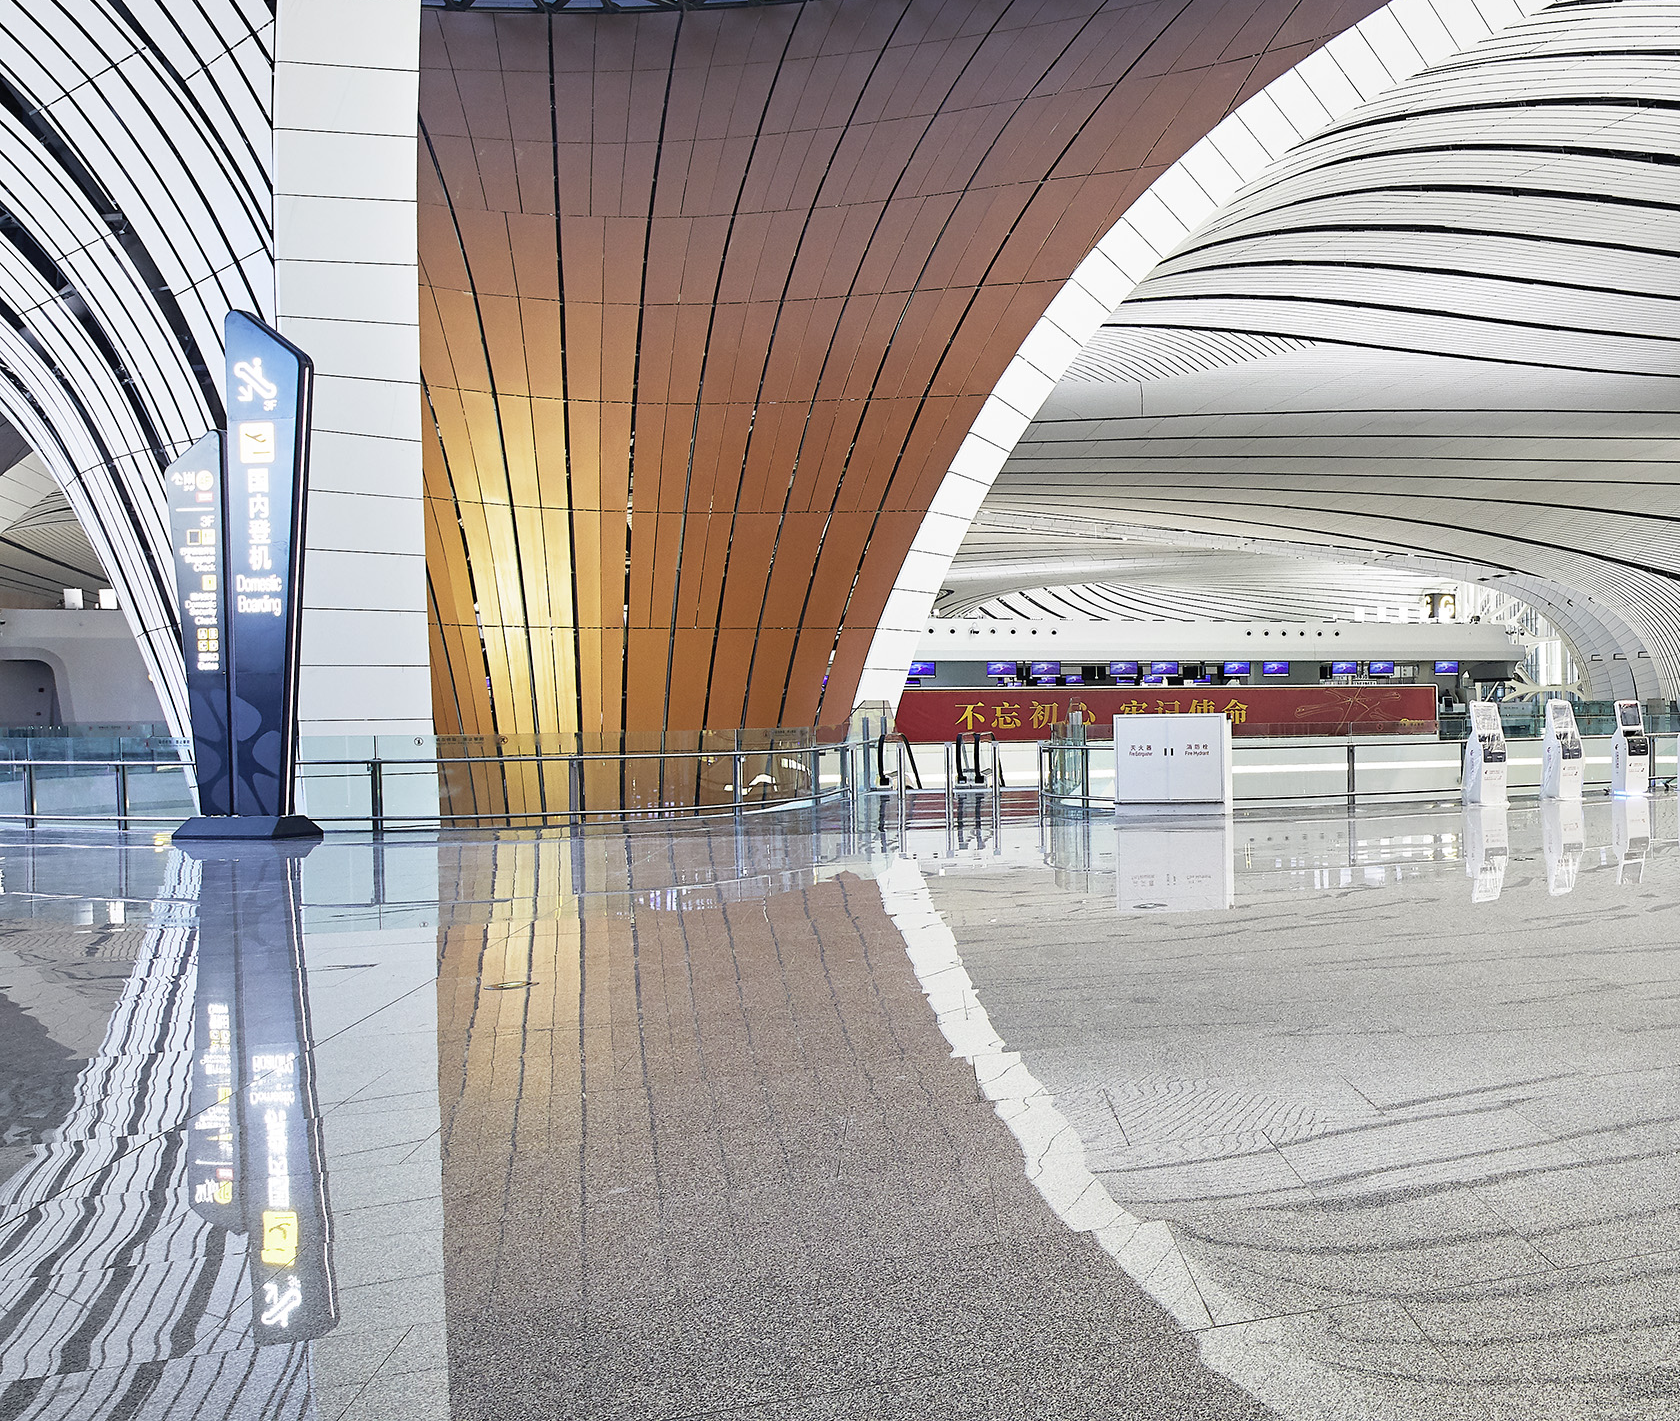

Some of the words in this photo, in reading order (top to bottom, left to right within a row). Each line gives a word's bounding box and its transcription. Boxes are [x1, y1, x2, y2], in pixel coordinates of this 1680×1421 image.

[247, 468, 272, 571] 国内登机
[236, 574, 282, 592] Domestic
[237, 595, 282, 617] Boarding
[1439, 595, 1455, 619] G
[955, 701, 1096, 730] 不忘初心
